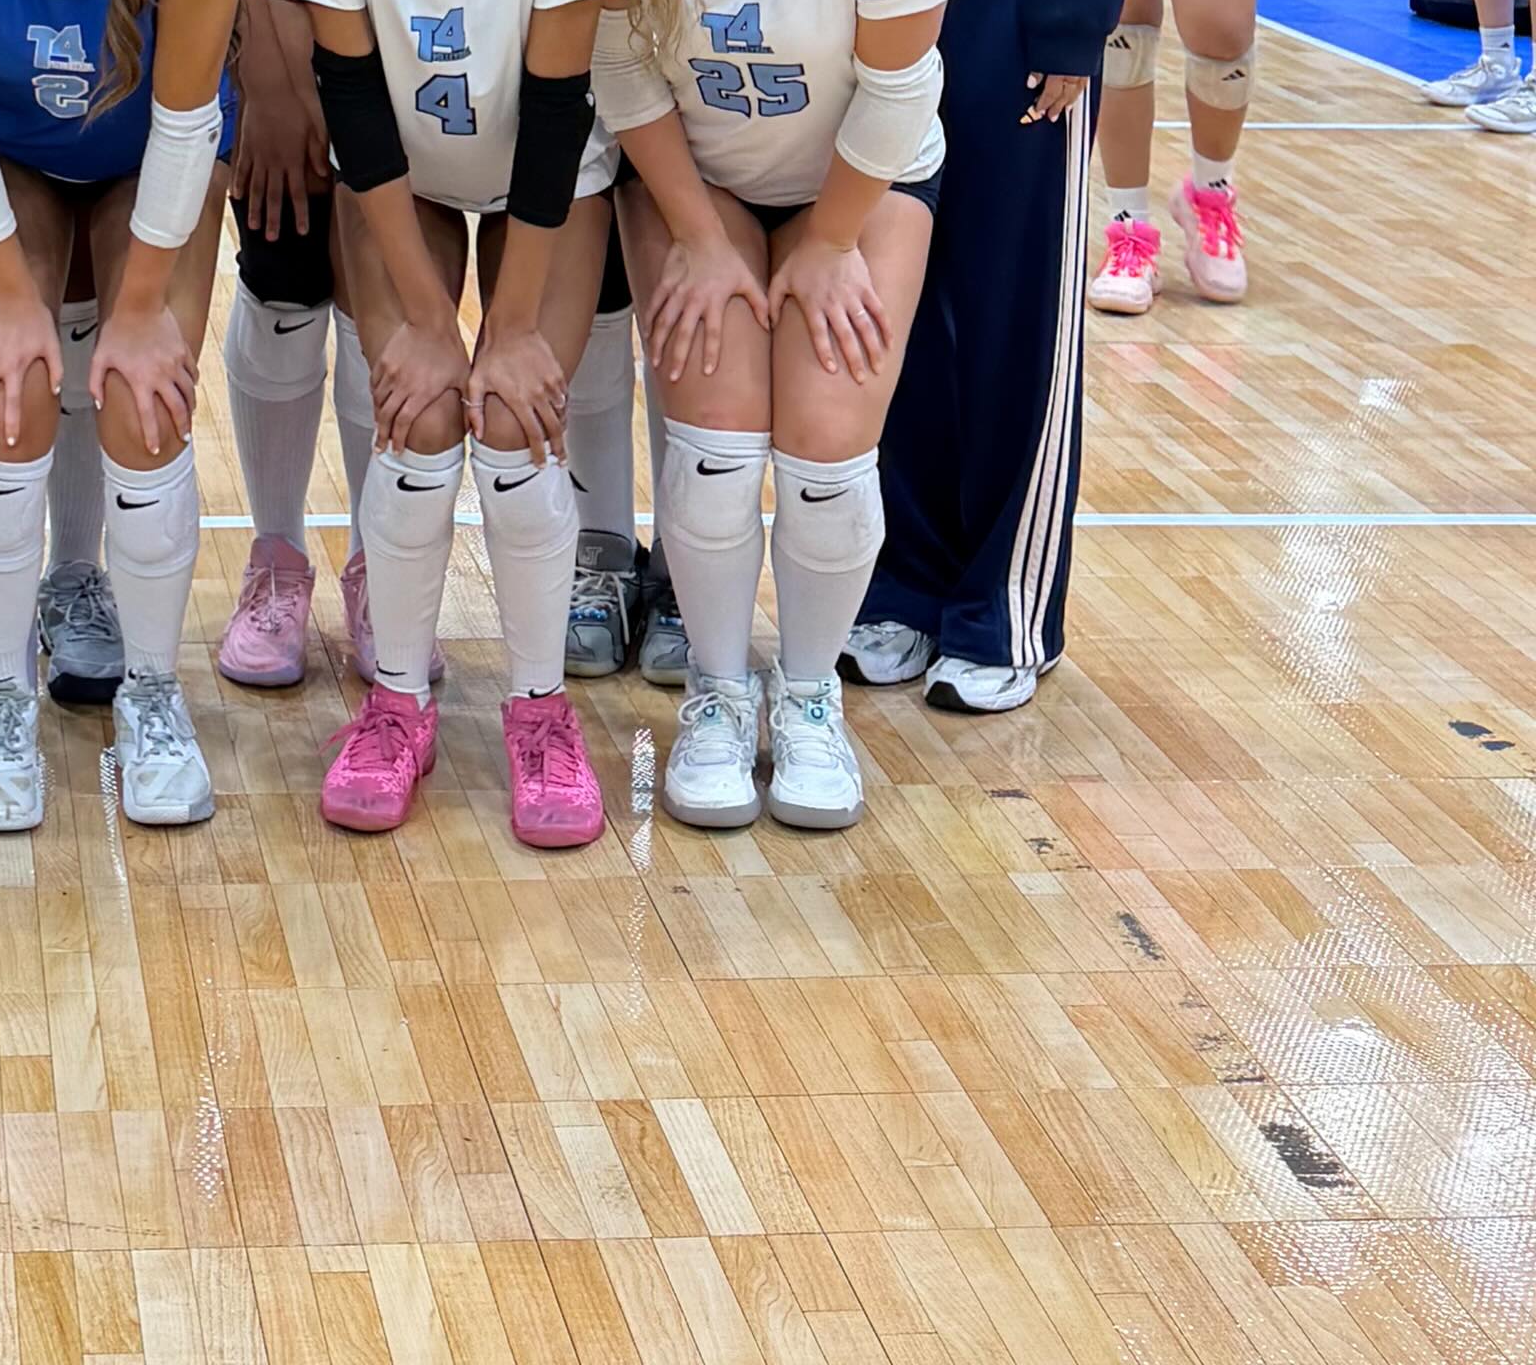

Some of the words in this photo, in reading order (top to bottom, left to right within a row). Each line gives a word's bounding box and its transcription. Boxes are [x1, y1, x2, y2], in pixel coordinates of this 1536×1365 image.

[26, 24, 88, 70] T4
[410, 6, 467, 63] T4
[701, 2, 764, 54] T4
[31, 74, 90, 119] 2
[415, 72, 478, 136] 4
[688, 57, 810, 120] 25
